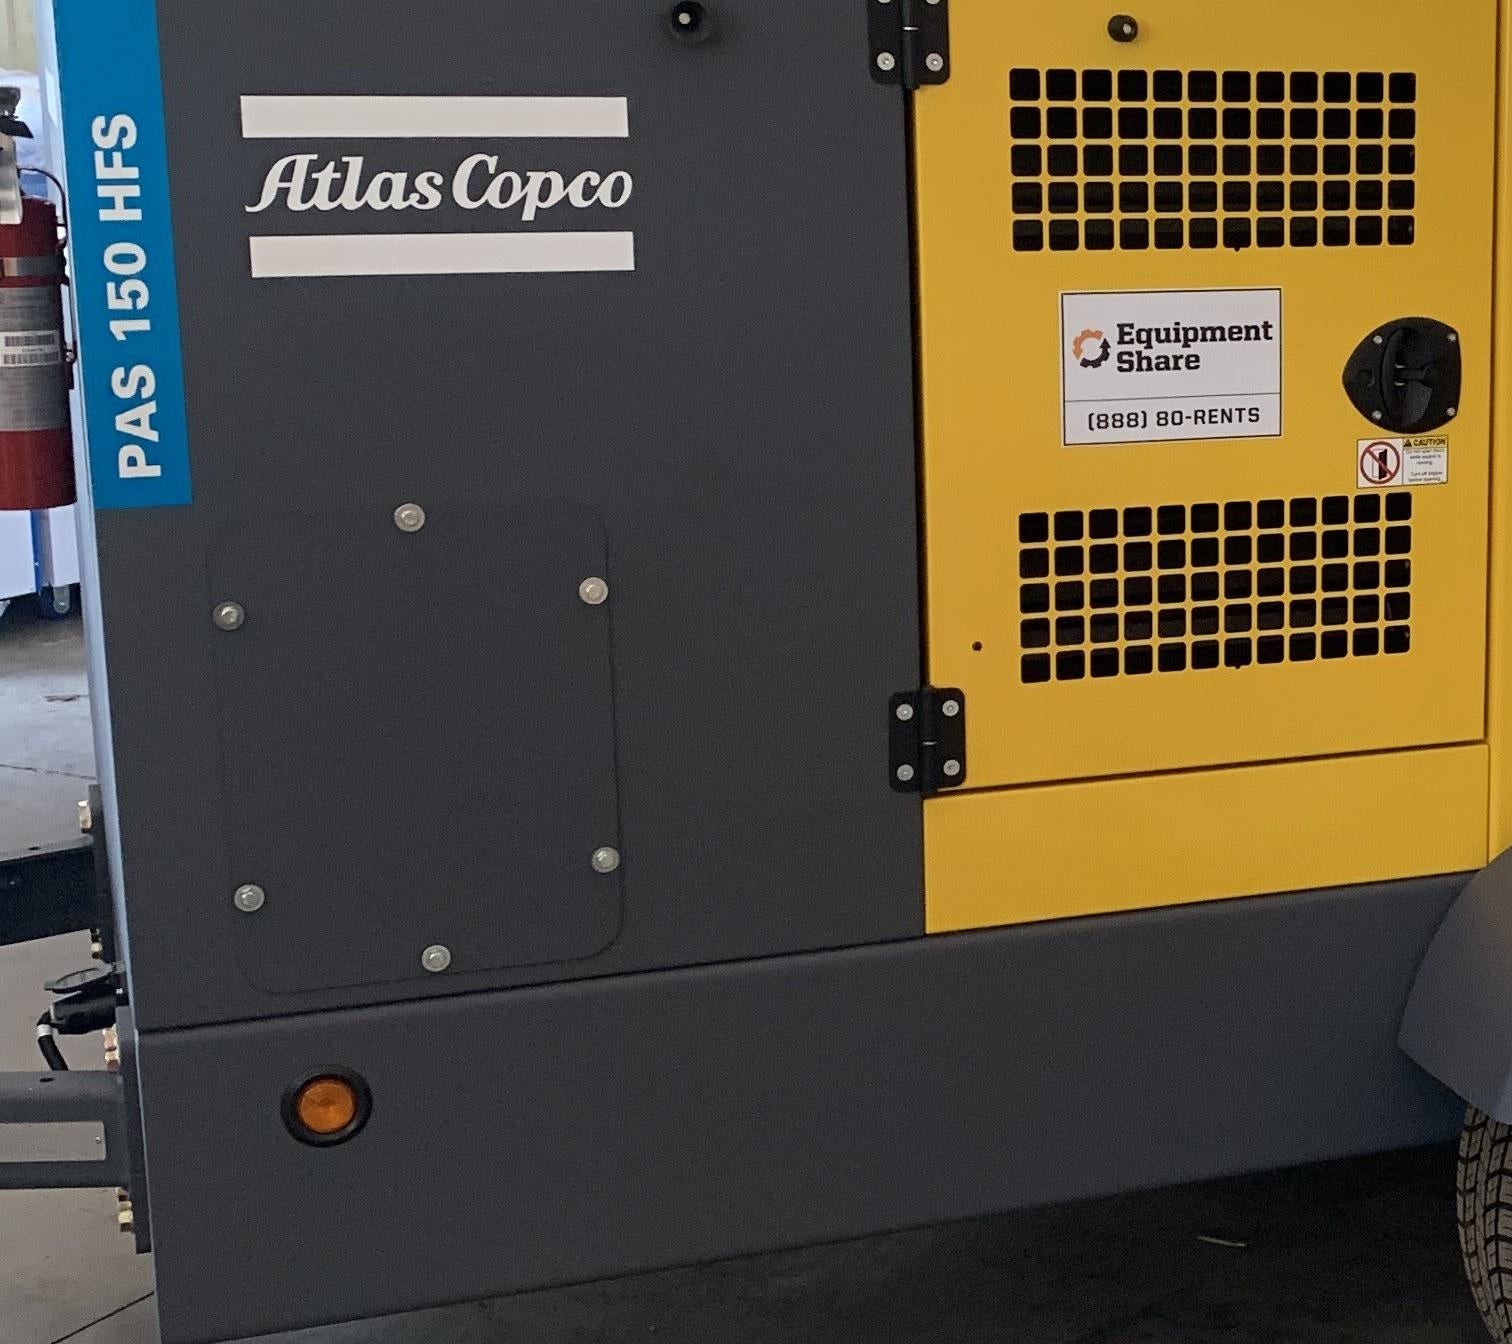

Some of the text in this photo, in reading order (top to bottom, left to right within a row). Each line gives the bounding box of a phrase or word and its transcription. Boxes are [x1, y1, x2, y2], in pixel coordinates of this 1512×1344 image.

[244, 153, 633, 222] Atlas Copco
[91, 113, 162, 479] PAS 150 HFS
[1116, 320, 1273, 350] Equipment
[1116, 350, 1201, 373] Share
[1088, 407, 1261, 431] (888) 80-RENTS
[1413, 439, 1446, 447] CAUTION
